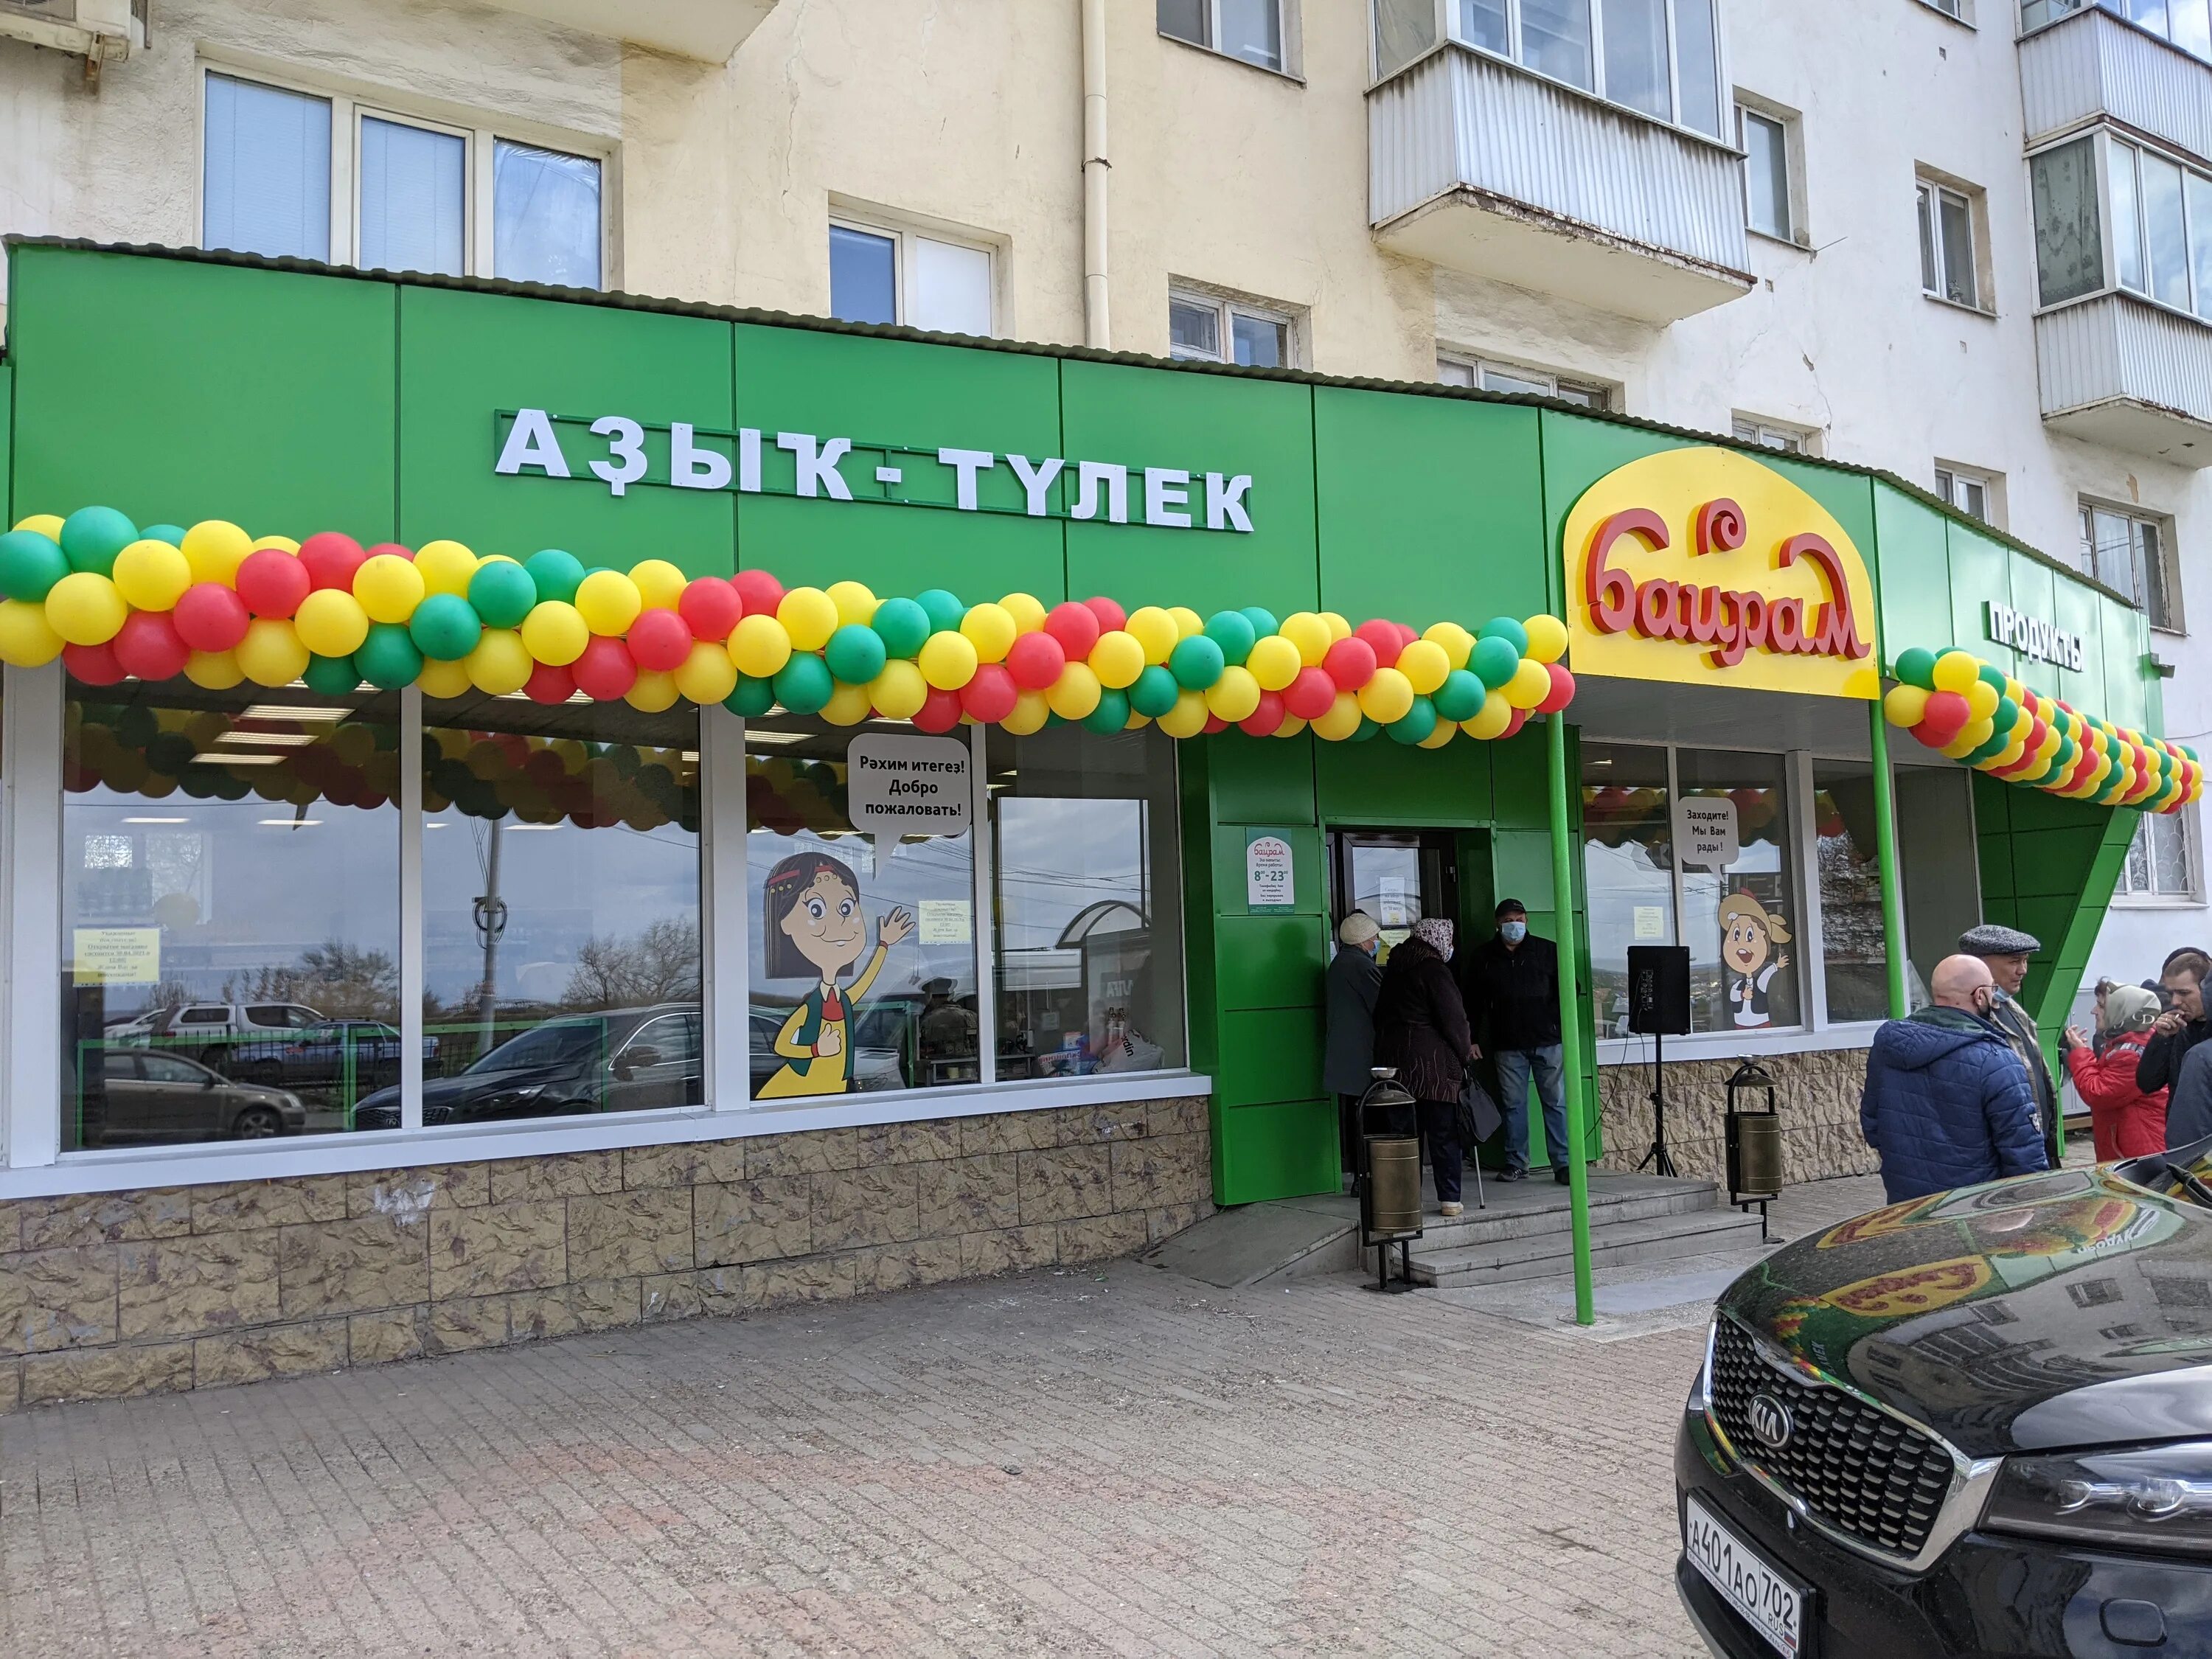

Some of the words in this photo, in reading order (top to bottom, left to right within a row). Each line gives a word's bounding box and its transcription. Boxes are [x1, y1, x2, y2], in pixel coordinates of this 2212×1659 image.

[1982, 599, 2084, 672] ПРОДУКТЫ
[860, 755, 908, 771] Рәхим
[888, 779, 939, 797] Добро
[865, 803, 961, 816] пожаловать!
[1686, 809, 1729, 821] Заходите!
[1692, 825, 1706, 835] Мы
[1711, 826, 1726, 835] Вам
[1751, 1399, 1778, 1441] KIA
[1761, 1571, 1793, 1631] 702
[1767, 1612, 1784, 1637] RUS
